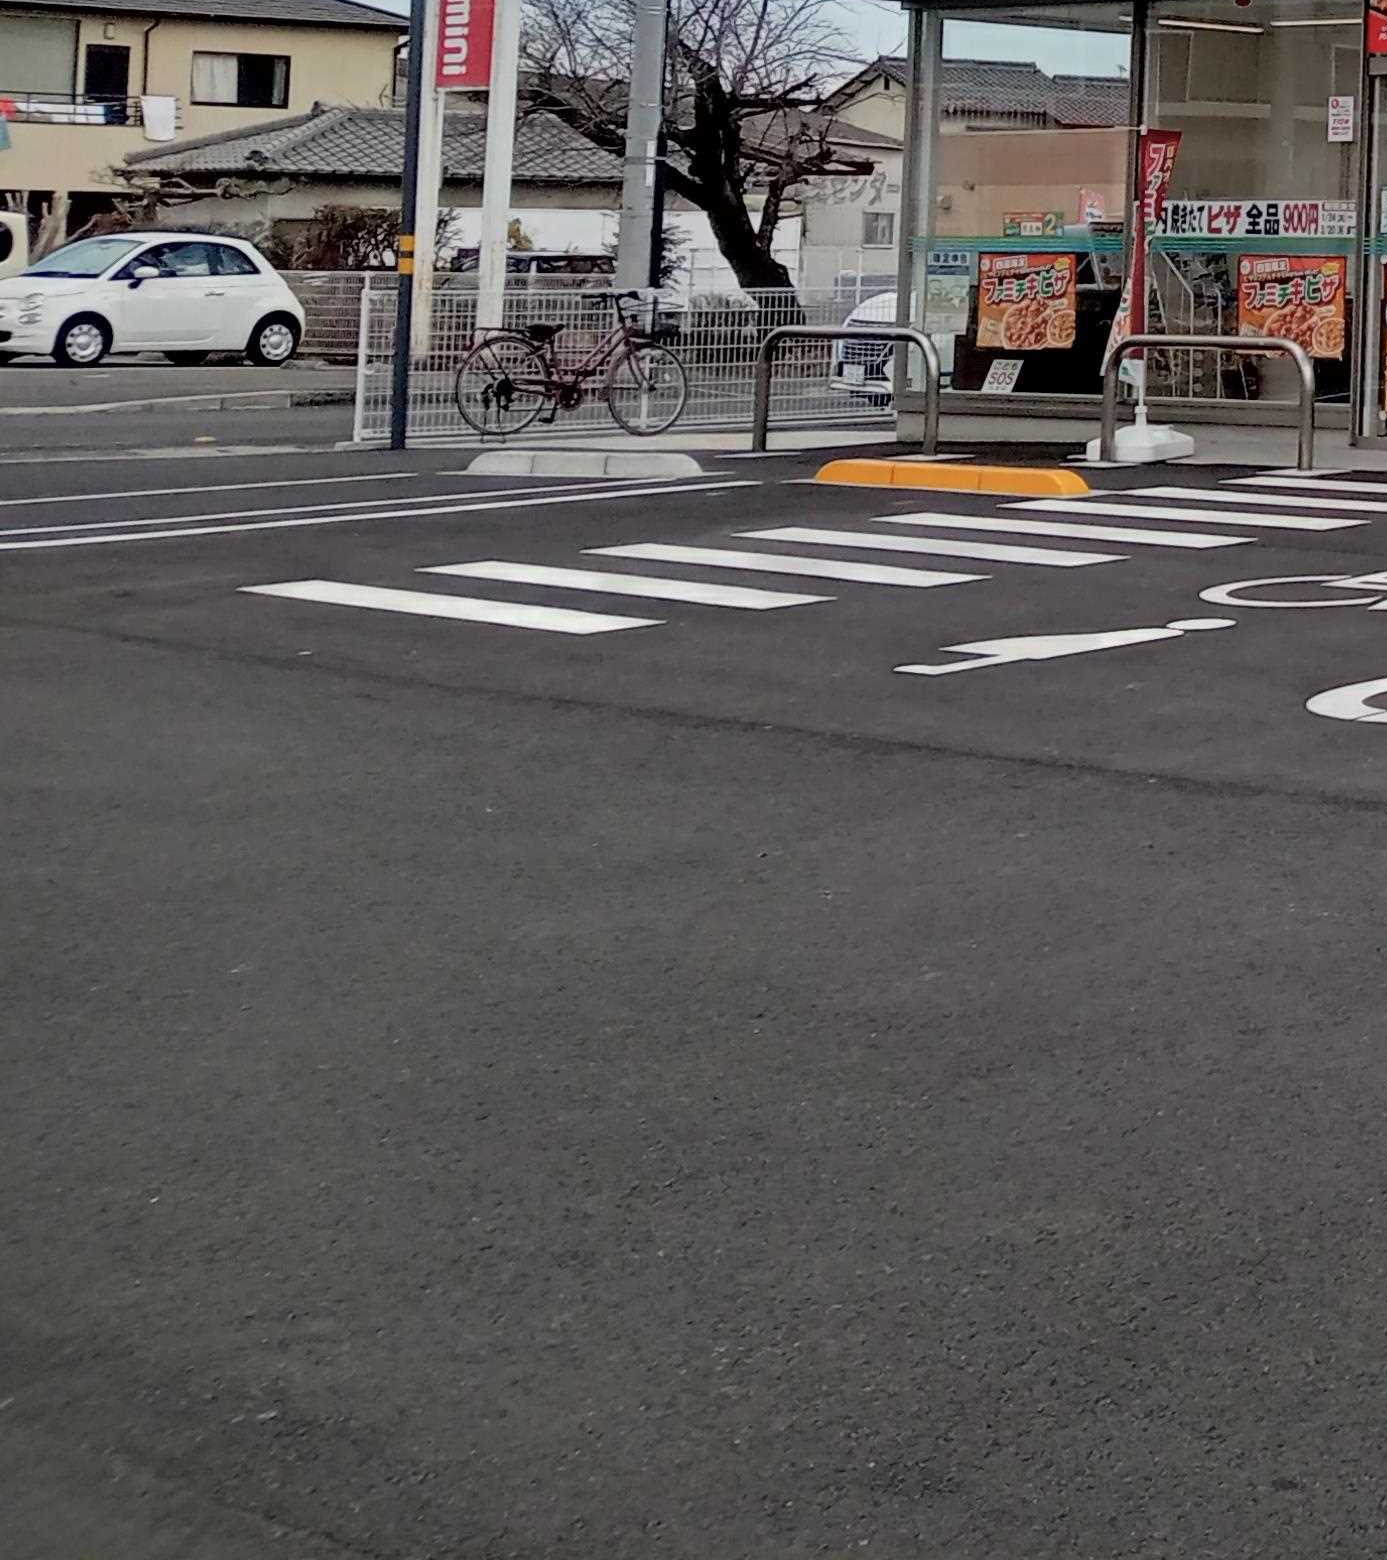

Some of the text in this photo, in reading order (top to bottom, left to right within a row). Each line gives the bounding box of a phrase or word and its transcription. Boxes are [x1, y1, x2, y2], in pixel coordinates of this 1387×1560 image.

[1207, 204, 1243, 234] ピザ
[1245, 204, 1280, 235] 全品
[1283, 204, 1319, 234] 900円
[982, 270, 1071, 303] ファミチキピザ
[1241, 273, 1340, 309] ファミチキピザ
[987, 371, 1014, 385] SOS
